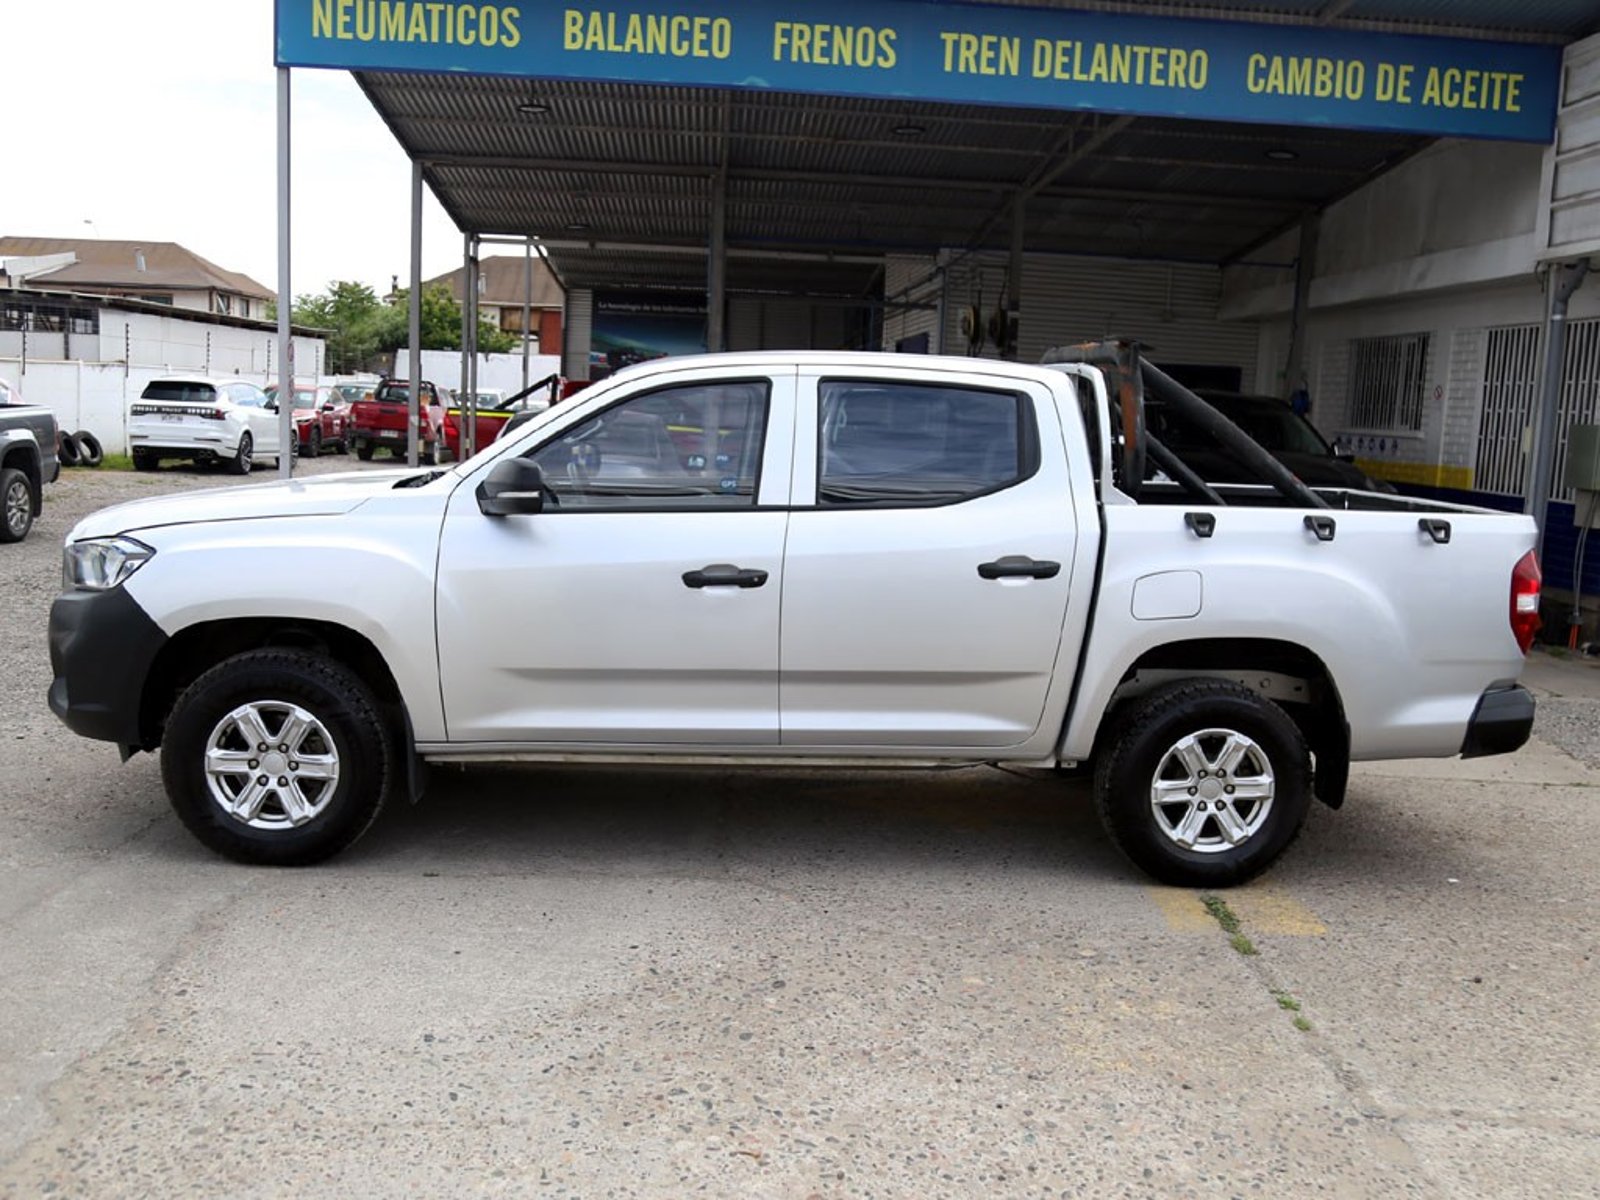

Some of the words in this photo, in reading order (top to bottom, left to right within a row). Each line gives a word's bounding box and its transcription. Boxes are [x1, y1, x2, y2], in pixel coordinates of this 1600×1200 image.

[312, 0, 520, 47] NEUMATICOS
[565, 9, 731, 59] BALANCEO
[774, 22, 897, 68] FRENOS
[941, 32, 1020, 77] TREN
[1033, 39, 1209, 90] DELANTERO
[1247, 53, 1365, 101] CAMBIO
[1375, 63, 1413, 104] DE
[1422, 67, 1524, 113] ACEITE
